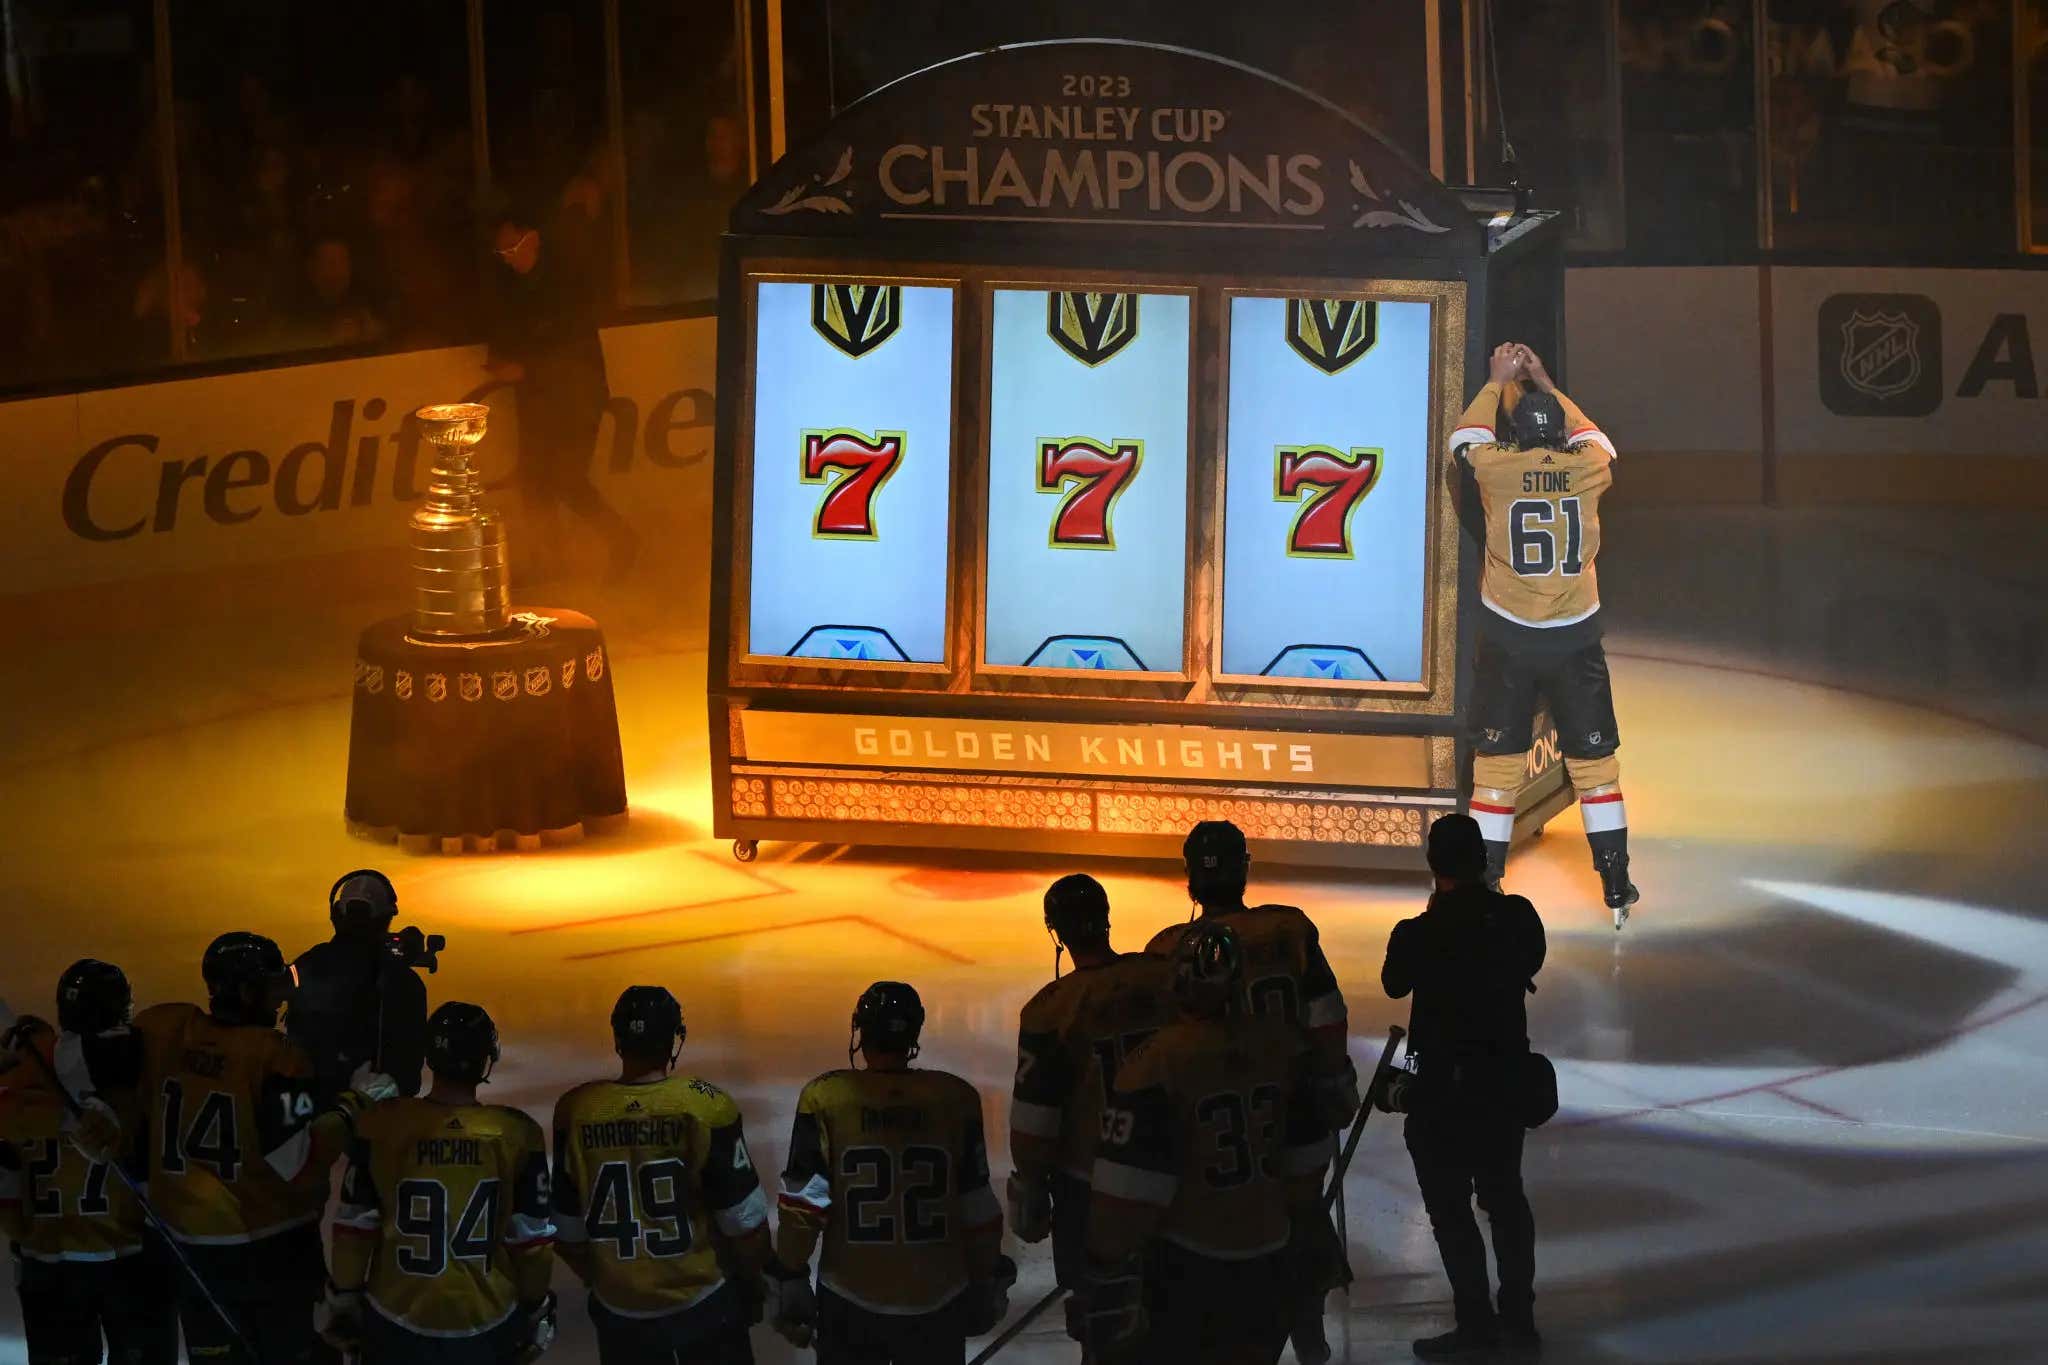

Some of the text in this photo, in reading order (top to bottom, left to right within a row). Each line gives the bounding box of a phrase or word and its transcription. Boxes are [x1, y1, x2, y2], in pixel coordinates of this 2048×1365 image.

[970, 104, 1226, 143] STANLEY CUP
[1062, 74, 1131, 98] 2023
[878, 144, 1326, 216] CHAMPIONS
[1536, 413, 1548, 425] 61
[62, 397, 425, 542] Credit
[800, 428, 1384, 560] 7 7 7
[1523, 471, 1571, 493] STONE
[1508, 496, 1582, 577] 61
[854, 727, 1315, 773] GOLDEN KNIGHTS
[161, 1077, 243, 1184] 14
[279, 1091, 315, 1126] 14
[396, 1177, 502, 1277] 94
[585, 1157, 695, 1260] 49
[841, 1144, 953, 1245] 22
